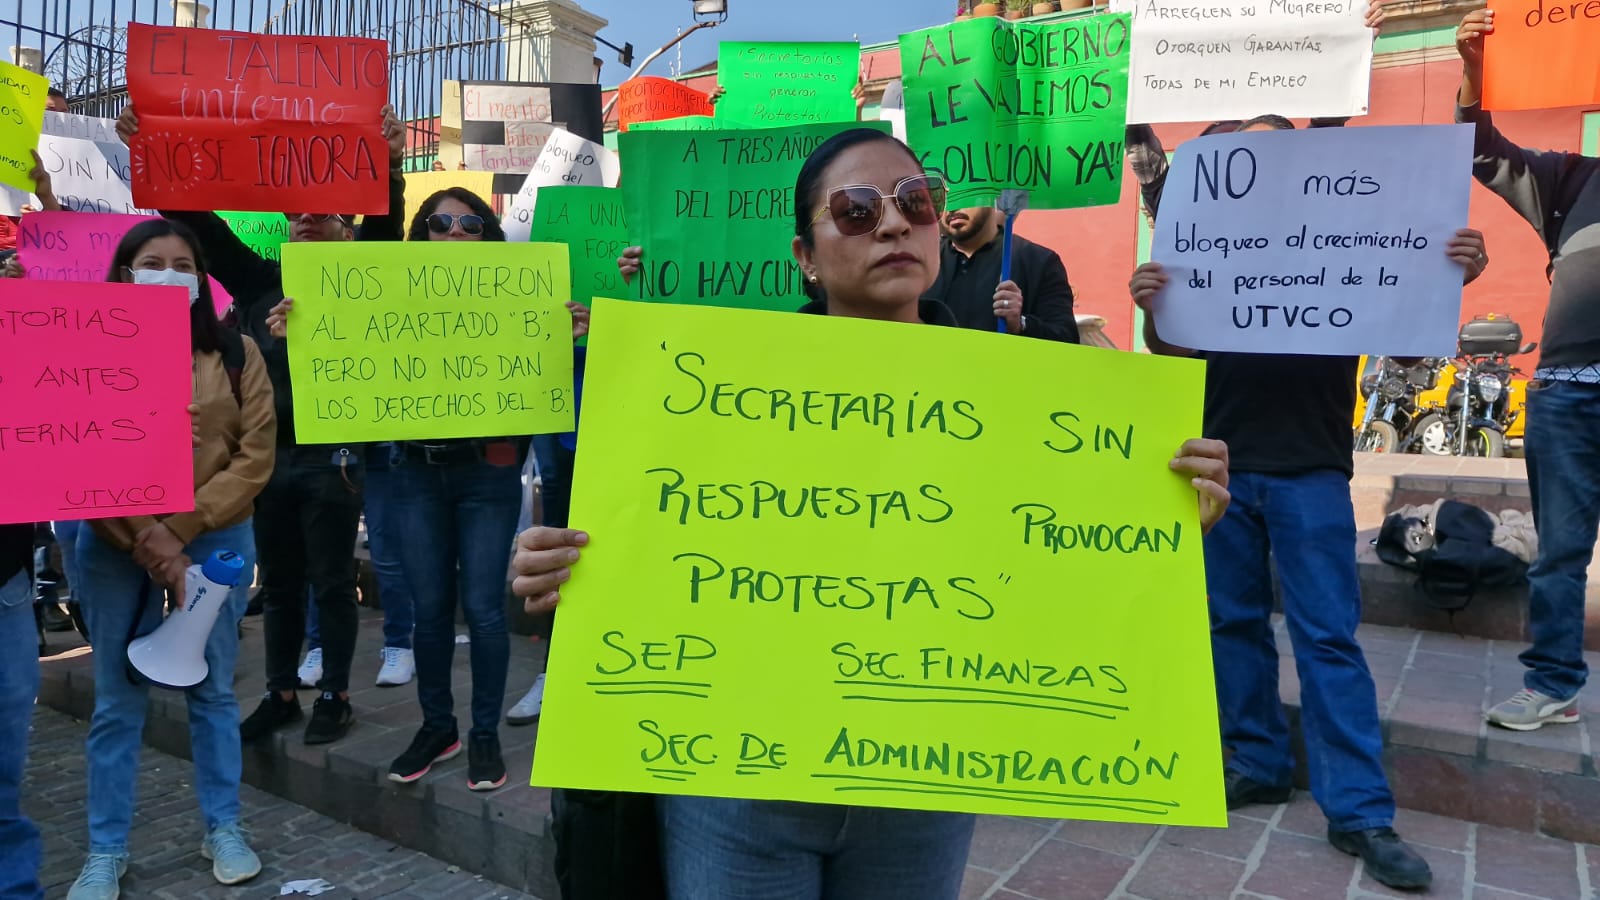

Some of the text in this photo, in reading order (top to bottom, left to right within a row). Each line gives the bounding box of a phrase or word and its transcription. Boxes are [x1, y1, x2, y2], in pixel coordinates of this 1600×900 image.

[149, 32, 389, 90] EL TALENTO
[918, 18, 1129, 77] AL GOBIERNO
[769, 87, 817, 99] generan
[774, 71, 837, 82] respuestas
[1143, 71, 1307, 90] TODAS DE MI EMPLEO
[170, 82, 357, 127] interno
[465, 89, 480, 118] El
[928, 69, 1113, 129] LE VALEMOS
[46, 142, 93, 181] SIN
[143, 141, 195, 185] NO
[200, 138, 235, 183] SE
[251, 135, 379, 189] IGNORA
[682, 138, 699, 164] A
[718, 136, 774, 165] TRES
[1066, 140, 1122, 186] YA!!
[1192, 147, 1381, 203] NO más
[546, 202, 570, 225] LA
[675, 189, 714, 219] DEL
[21, 222, 69, 251] Nos
[1175, 221, 1429, 259] bloqueo al crecimiento
[321, 262, 383, 301] NOS
[408, 260, 553, 299] MOVIERON
[639, 260, 680, 299] NO
[698, 261, 753, 298] HAY
[1188, 265, 1399, 295] del personal de la
[311, 314, 346, 340] AL
[365, 311, 498, 343] APARTADO
[1232, 305, 1354, 330] UTVCO
[34, 366, 140, 395] ANTES
[312, 351, 542, 383] PERO NO NOS DAN
[316, 396, 358, 420] LOS
[372, 392, 486, 423] DERECHOS
[497, 391, 534, 415] DEL
[1043, 411, 1134, 459] SIN
[65, 484, 166, 507] UTVCO
[645, 468, 1182, 554] RESPUESTAS PROVOCAN
[595, 631, 717, 675] SEP
[831, 642, 1128, 693] SEC. FINANZAS
[638, 719, 1180, 786] SEC. DE ADMINISTRACIÓN
